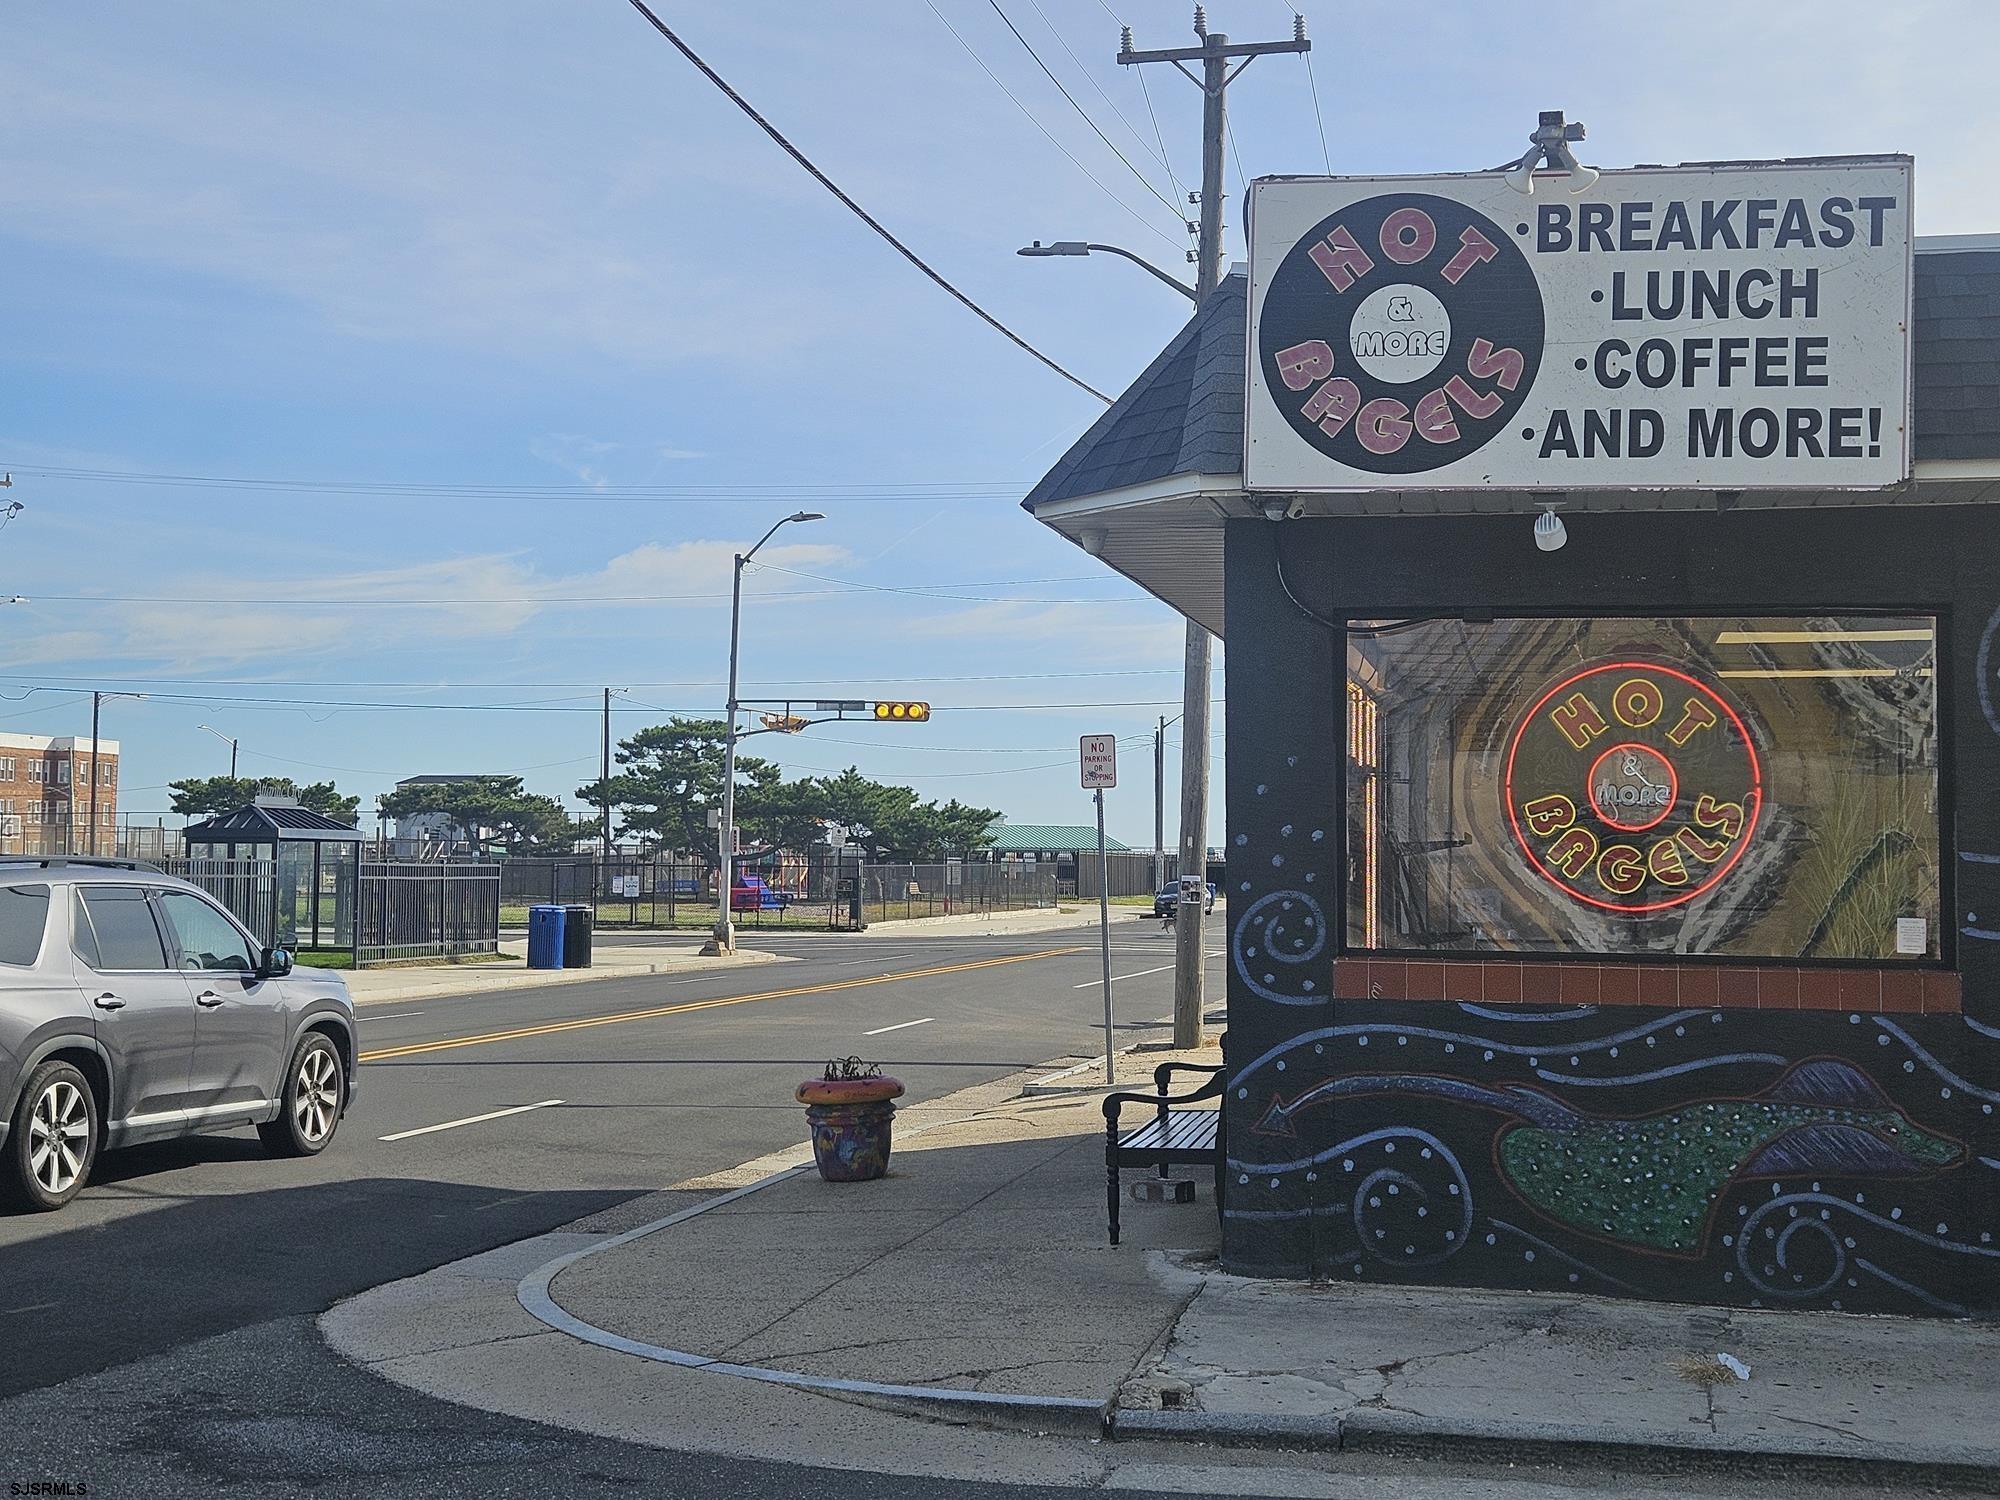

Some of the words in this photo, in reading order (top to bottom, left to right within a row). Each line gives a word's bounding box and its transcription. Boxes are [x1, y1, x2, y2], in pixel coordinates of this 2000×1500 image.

[1308, 207, 1499, 293] HOT
[1537, 196, 1896, 254] BREAKFAST
[1387, 296, 1415, 322] &
[1611, 268, 1819, 321] LUNCH
[1356, 331, 1444, 357] MORE
[1594, 336, 1829, 389] COFFEE
[1274, 337, 1525, 455] BAGELS
[1538, 408, 1664, 459] AND
[1688, 407, 1882, 459] MORE!
[1551, 679, 1716, 749] HOT
[1084, 755, 1112, 763] PARKING
[1091, 742, 1105, 753] NO
[1093, 764, 1103, 772] OR
[1621, 754, 1648, 777] &
[1595, 784, 1671, 807] MORE
[1524, 793, 1746, 895] BAGELS
